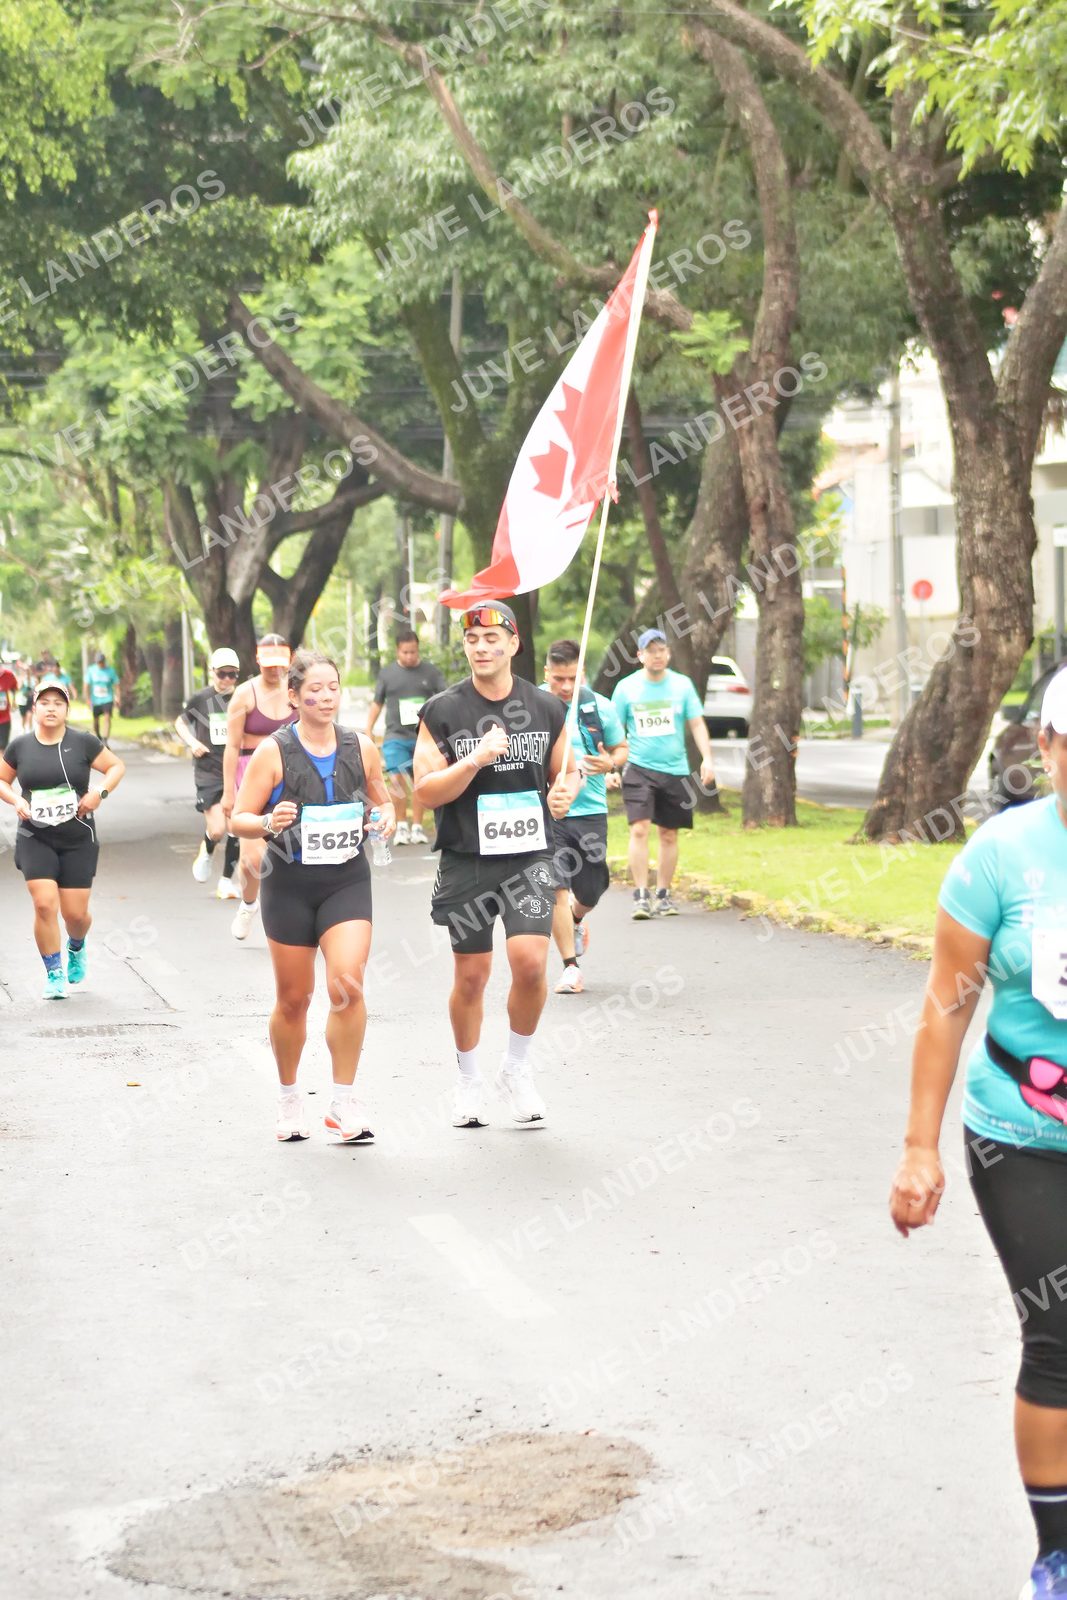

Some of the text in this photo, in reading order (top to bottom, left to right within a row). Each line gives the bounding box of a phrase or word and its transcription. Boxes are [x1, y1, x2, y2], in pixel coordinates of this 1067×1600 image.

[494, 762, 524, 772] TORONTO
[35, 803, 75, 819] 2125
[484, 818, 539, 840] 6489
[307, 829, 360, 851] 5625
